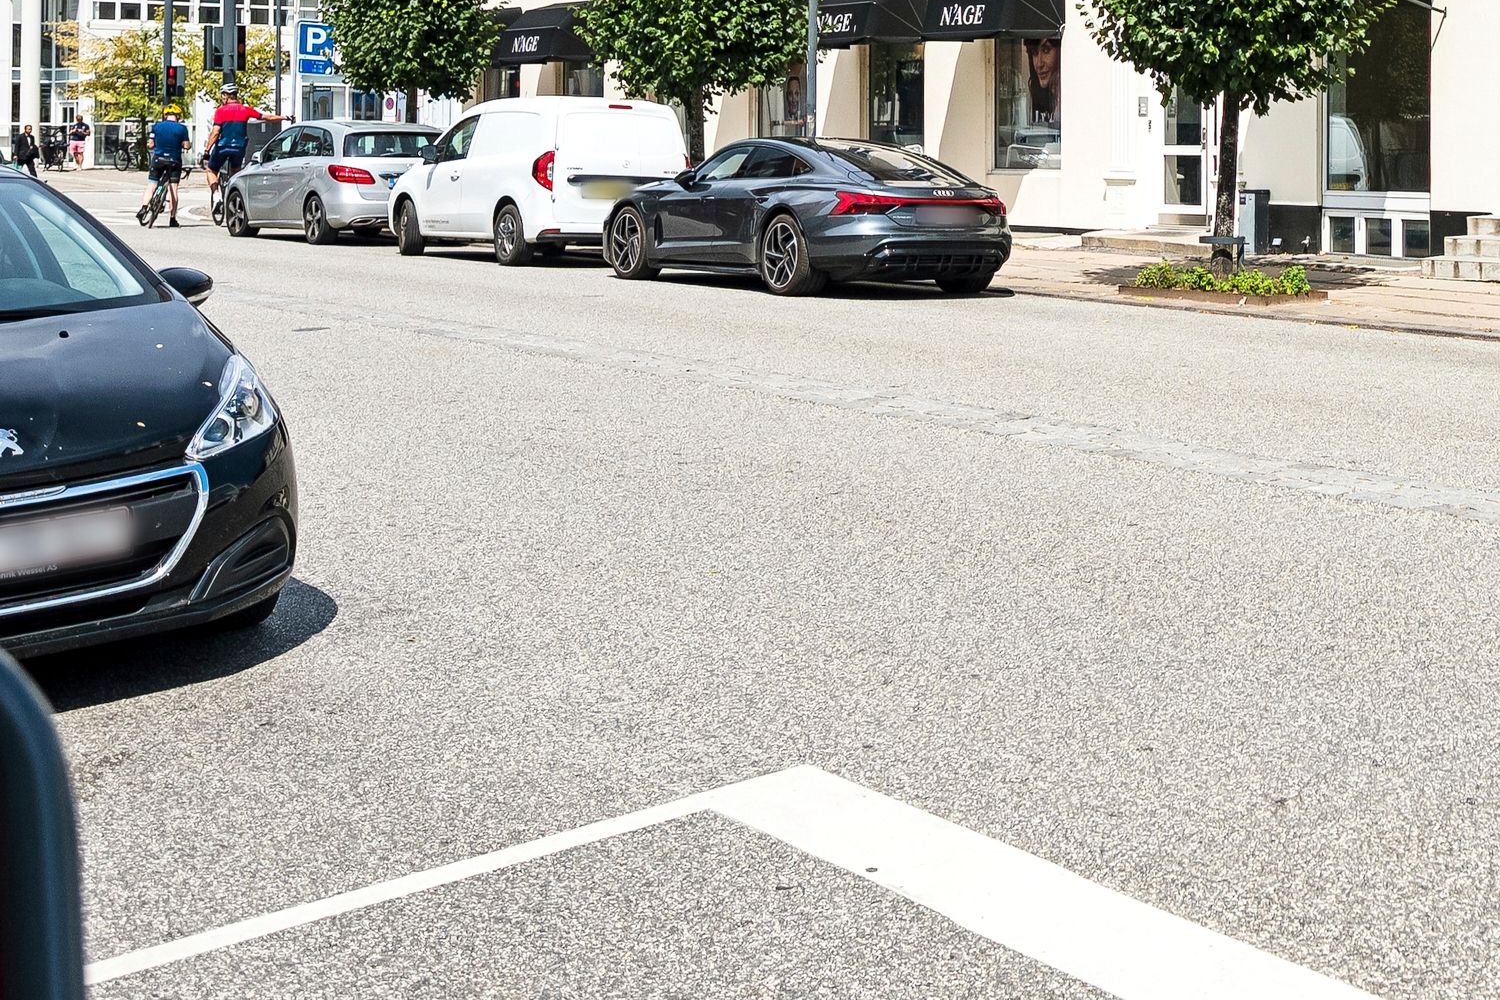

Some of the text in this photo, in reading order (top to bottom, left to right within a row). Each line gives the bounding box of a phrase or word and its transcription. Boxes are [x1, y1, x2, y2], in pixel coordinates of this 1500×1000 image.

[940, 3, 986, 26] N'AGE
[306, 26, 327, 53] P
[511, 34, 540, 53] N'AGE
